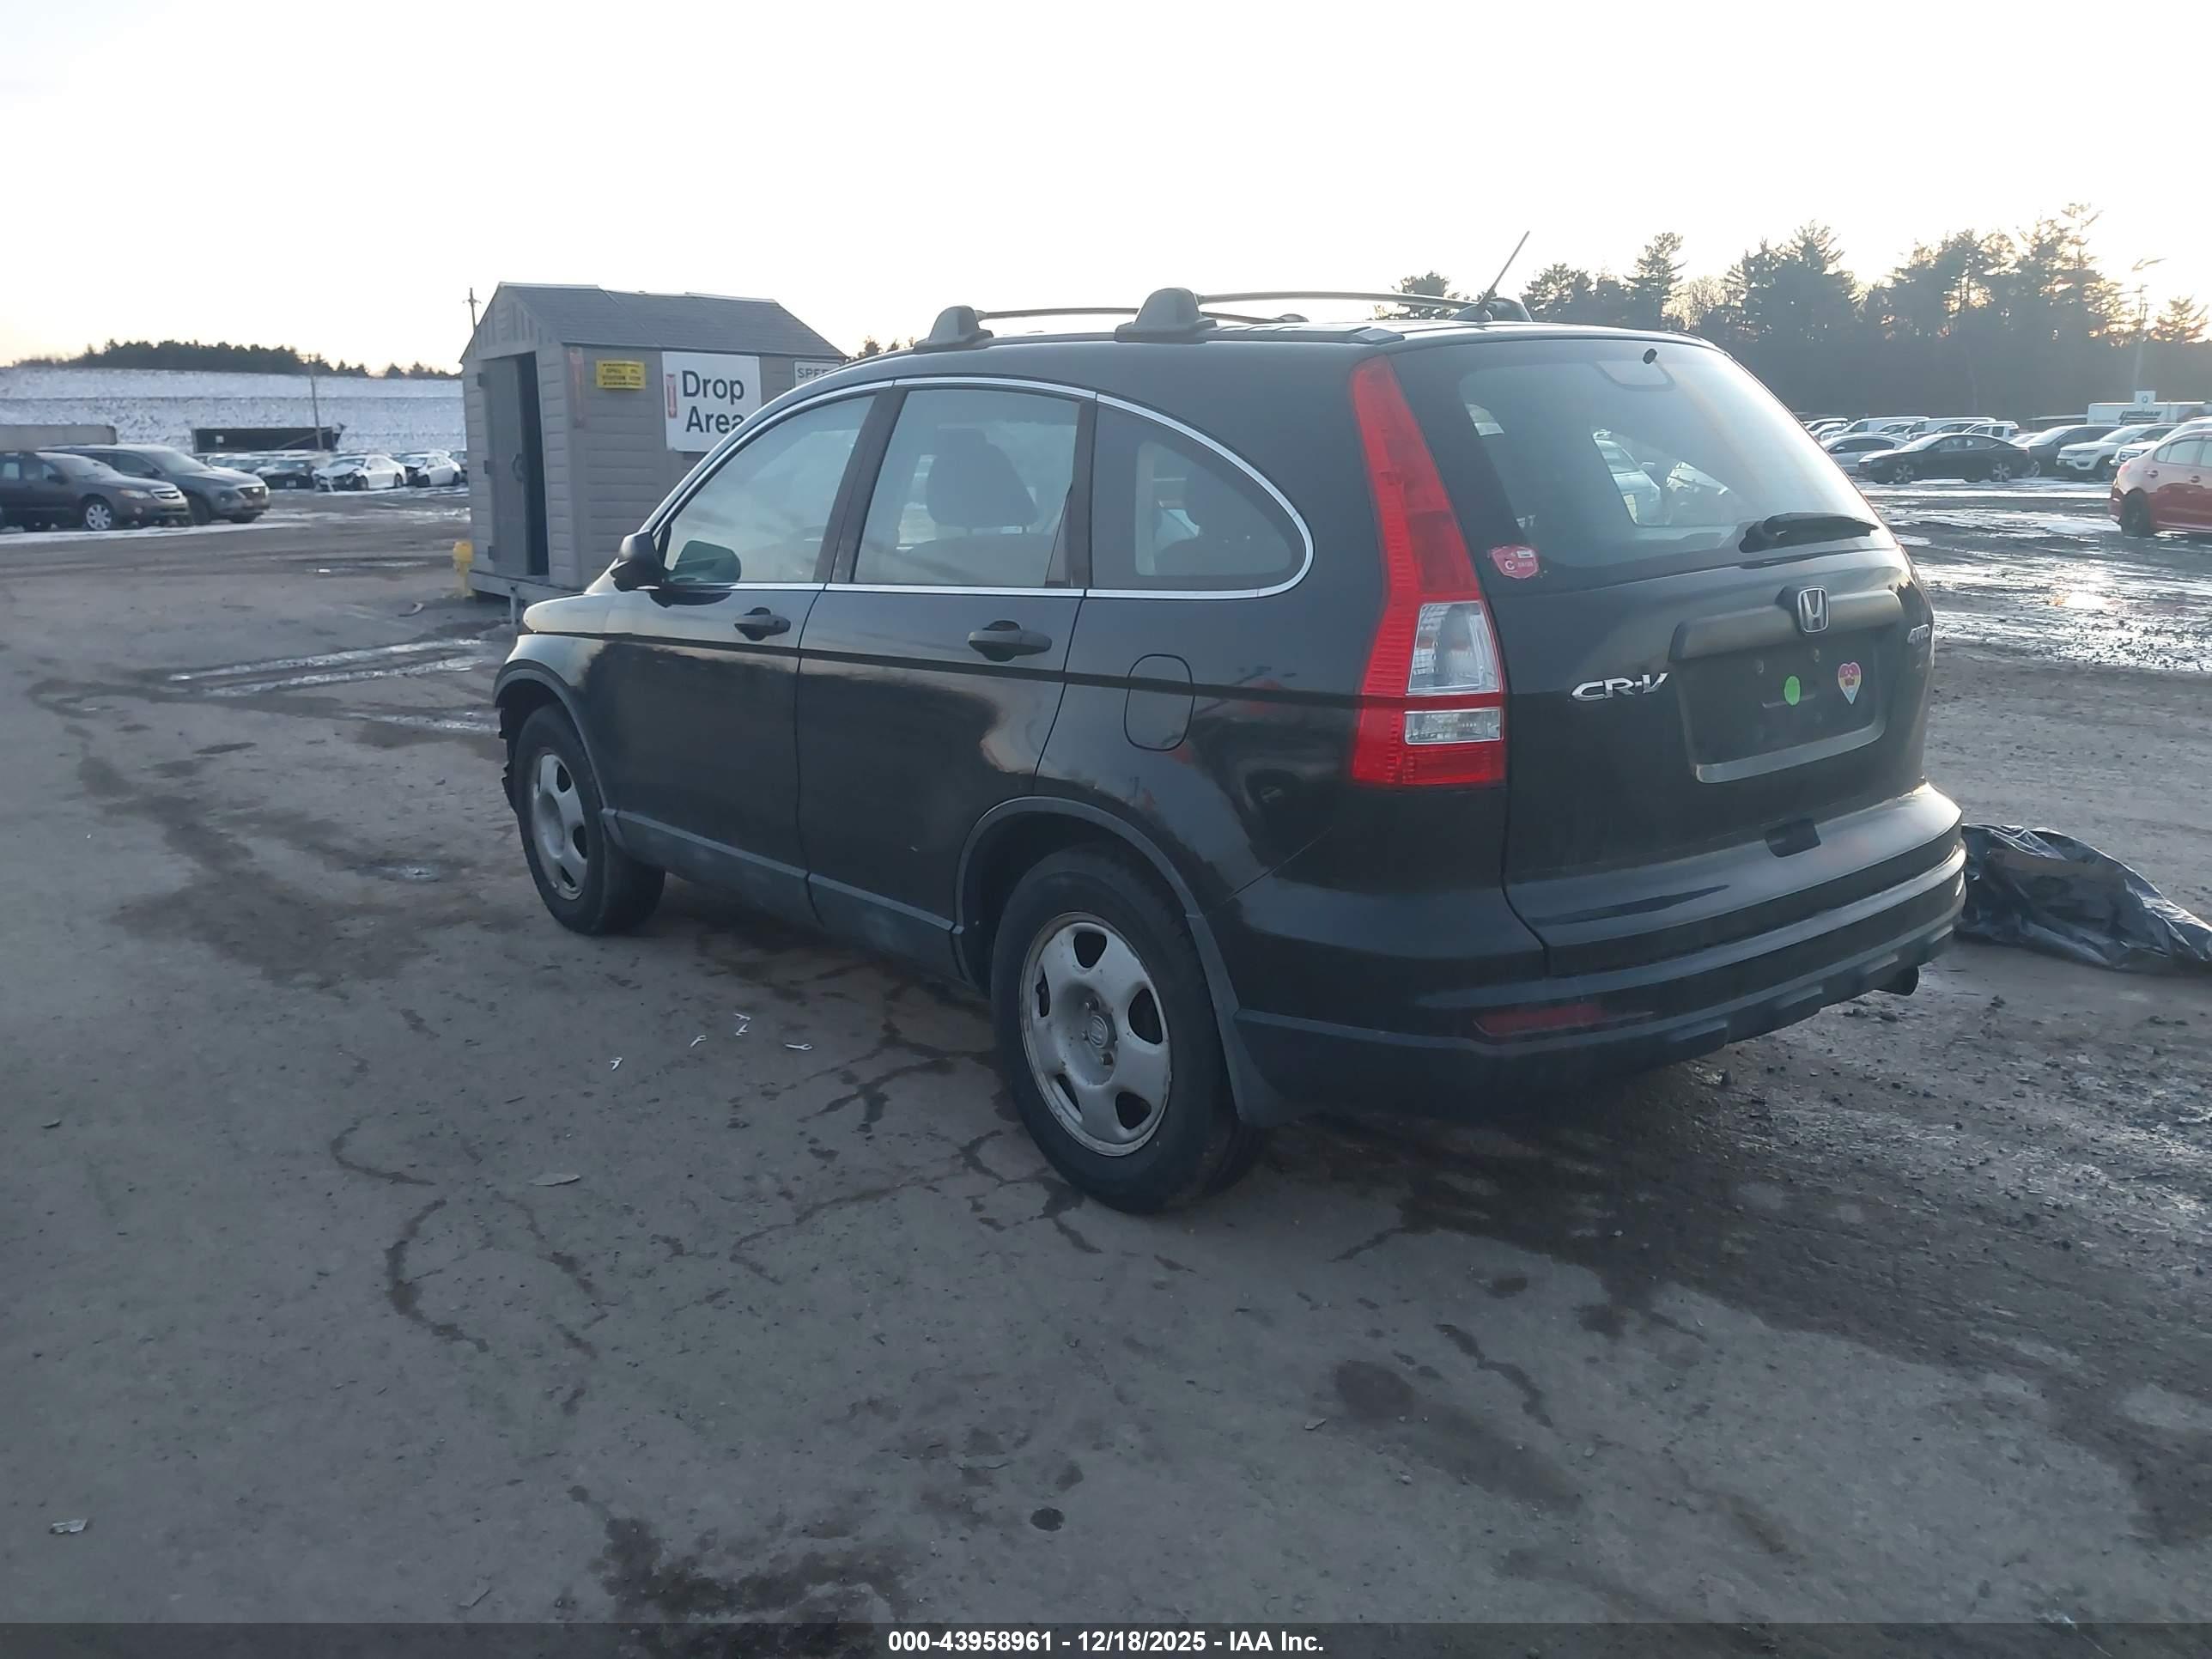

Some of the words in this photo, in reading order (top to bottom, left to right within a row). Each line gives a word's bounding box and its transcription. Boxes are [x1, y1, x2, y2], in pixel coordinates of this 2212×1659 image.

[683, 371, 744, 405] Drop
[685, 405, 744, 434] Area
[1571, 672, 1669, 701] CR-V
